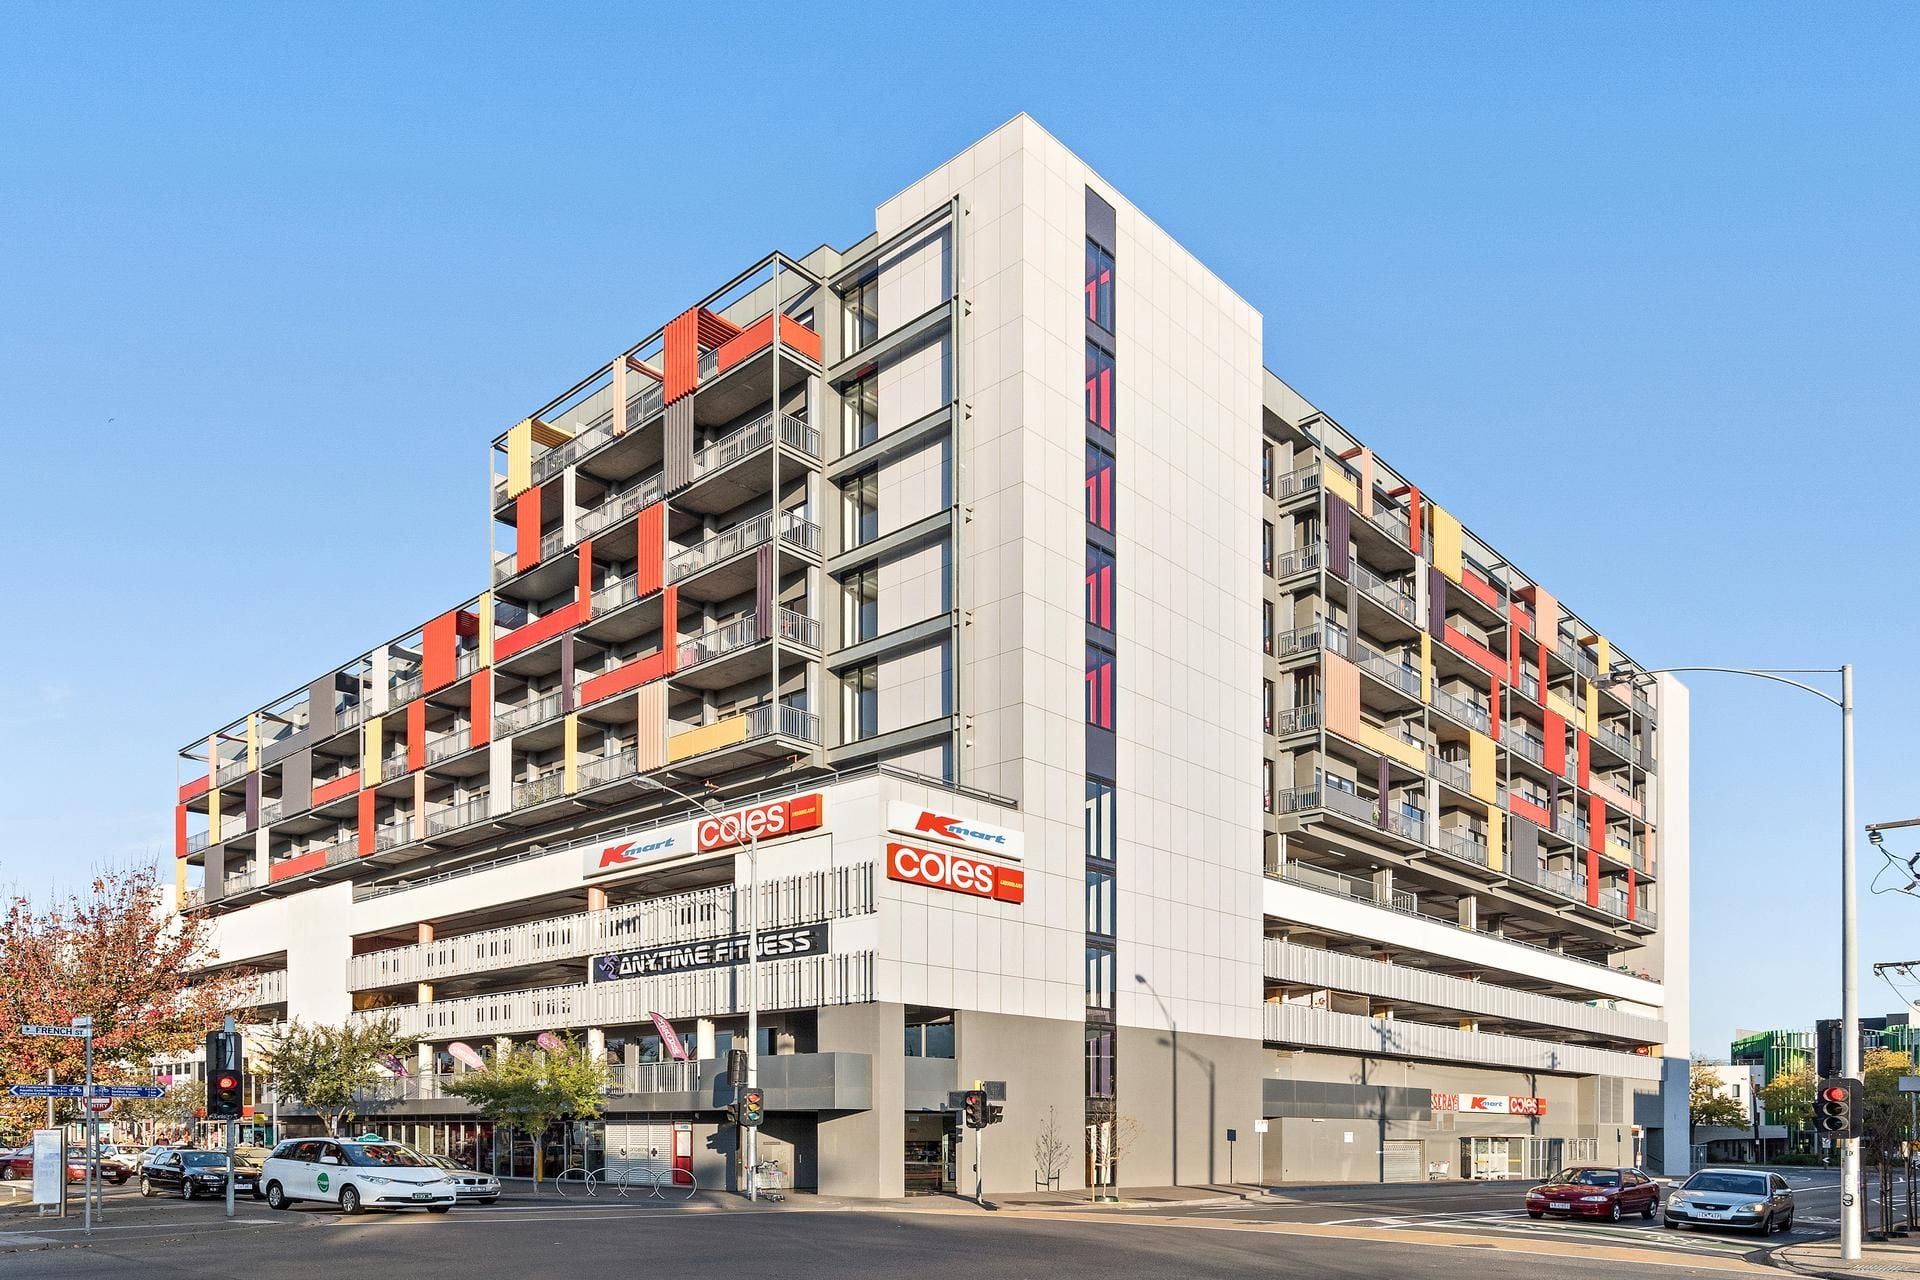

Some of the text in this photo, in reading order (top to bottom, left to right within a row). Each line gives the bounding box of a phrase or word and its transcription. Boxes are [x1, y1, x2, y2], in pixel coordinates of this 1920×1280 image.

[699, 803, 785, 848] coles
[915, 810, 1006, 845] Kmart
[599, 837, 675, 868] Kmart
[894, 847, 993, 894] coles
[618, 930, 812, 975] ANYTIME FITNESS
[36, 1027, 72, 1035] FRENCH
[1470, 1096, 1503, 1110] Kmart
[1510, 1097, 1538, 1114] coles
